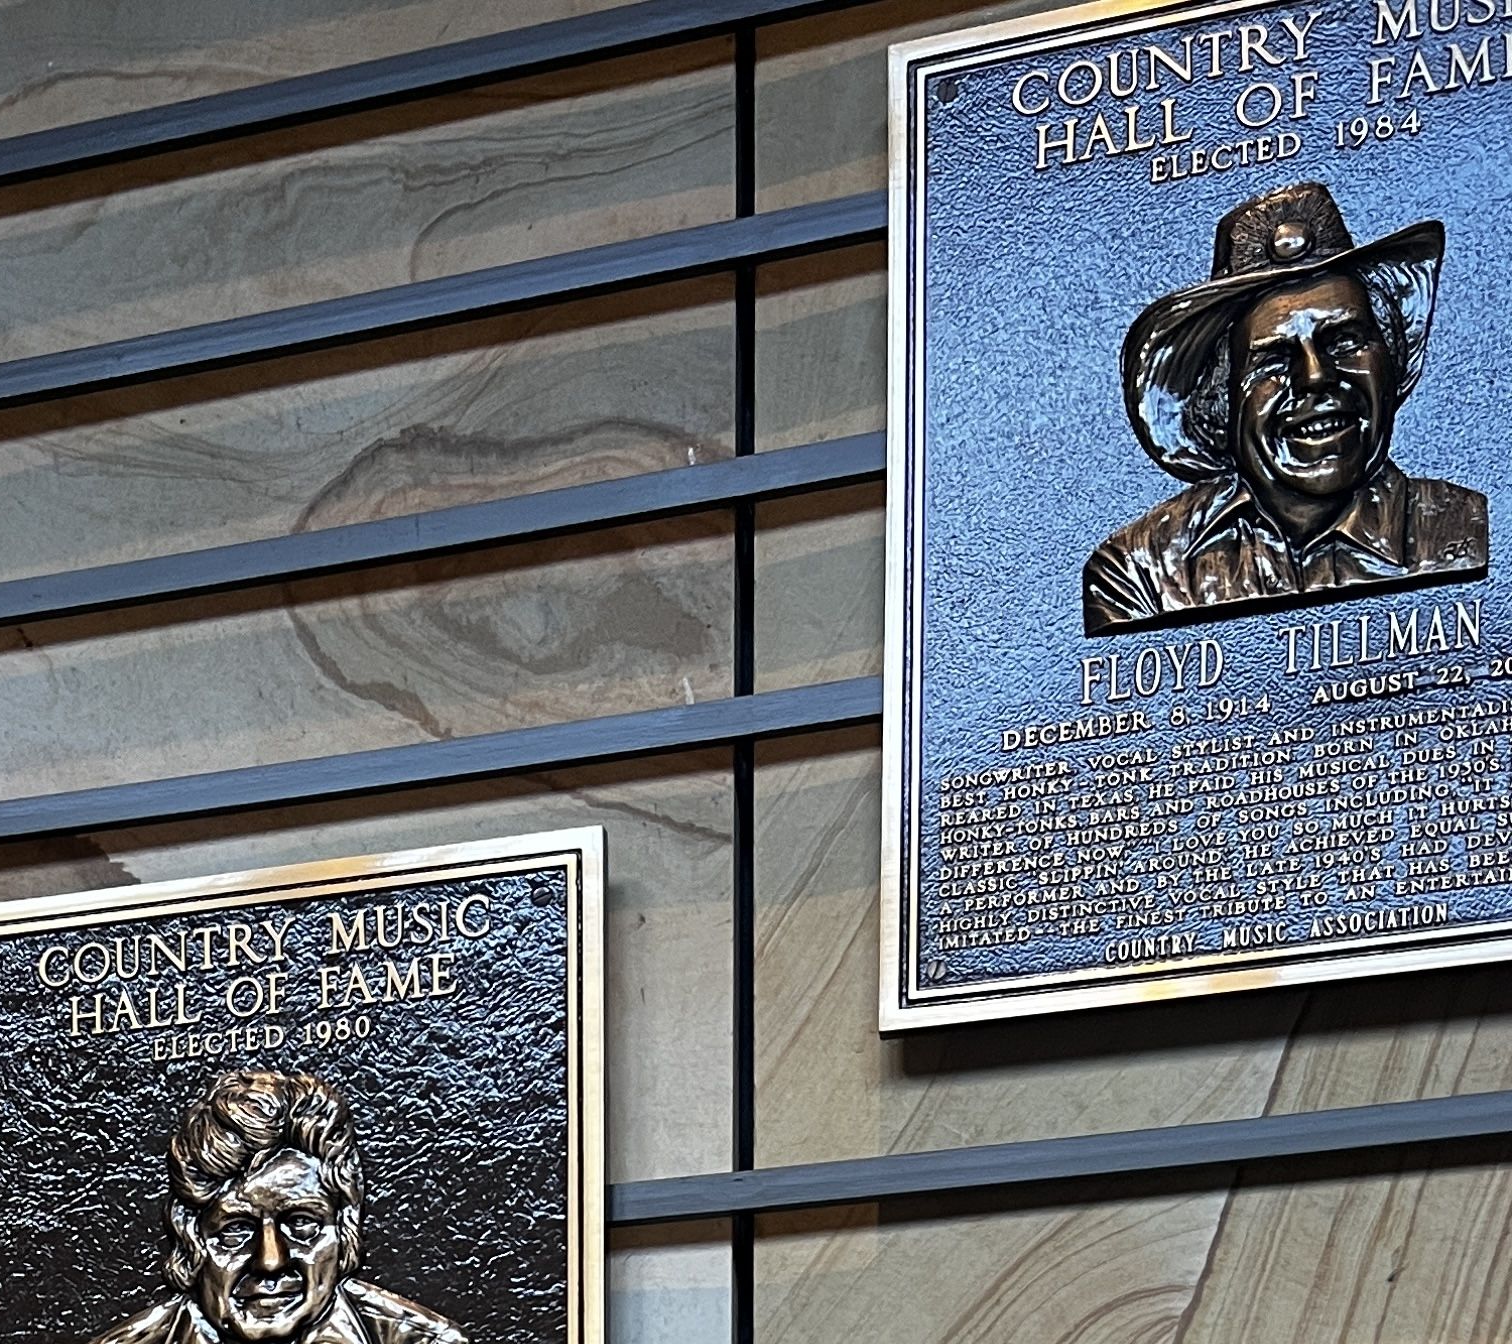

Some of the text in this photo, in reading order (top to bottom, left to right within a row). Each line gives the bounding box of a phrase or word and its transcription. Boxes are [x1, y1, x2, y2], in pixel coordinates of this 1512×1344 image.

[1011, 11, 1322, 117] COUNTRY
[1034, 98, 1192, 171] HALL
[1237, 71, 1318, 129] OF
[1151, 107, 1422, 185] ELECTED 1984
[1080, 599, 1481, 704] FLOYD TILLMAN
[1312, 671, 1419, 705] AUGUST
[1437, 665, 1471, 686] 22,
[1001, 711, 1152, 751] DECEMBER
[1205, 694, 1271, 723] 1914
[38, 893, 493, 989] COUNTRY MUSIC
[1105, 904, 1449, 963] COUNTRY MUSIC ASSOCIATION
[69, 953, 459, 1038] HALL OF FAME
[153, 1014, 371, 1062] ELECTED 1980
